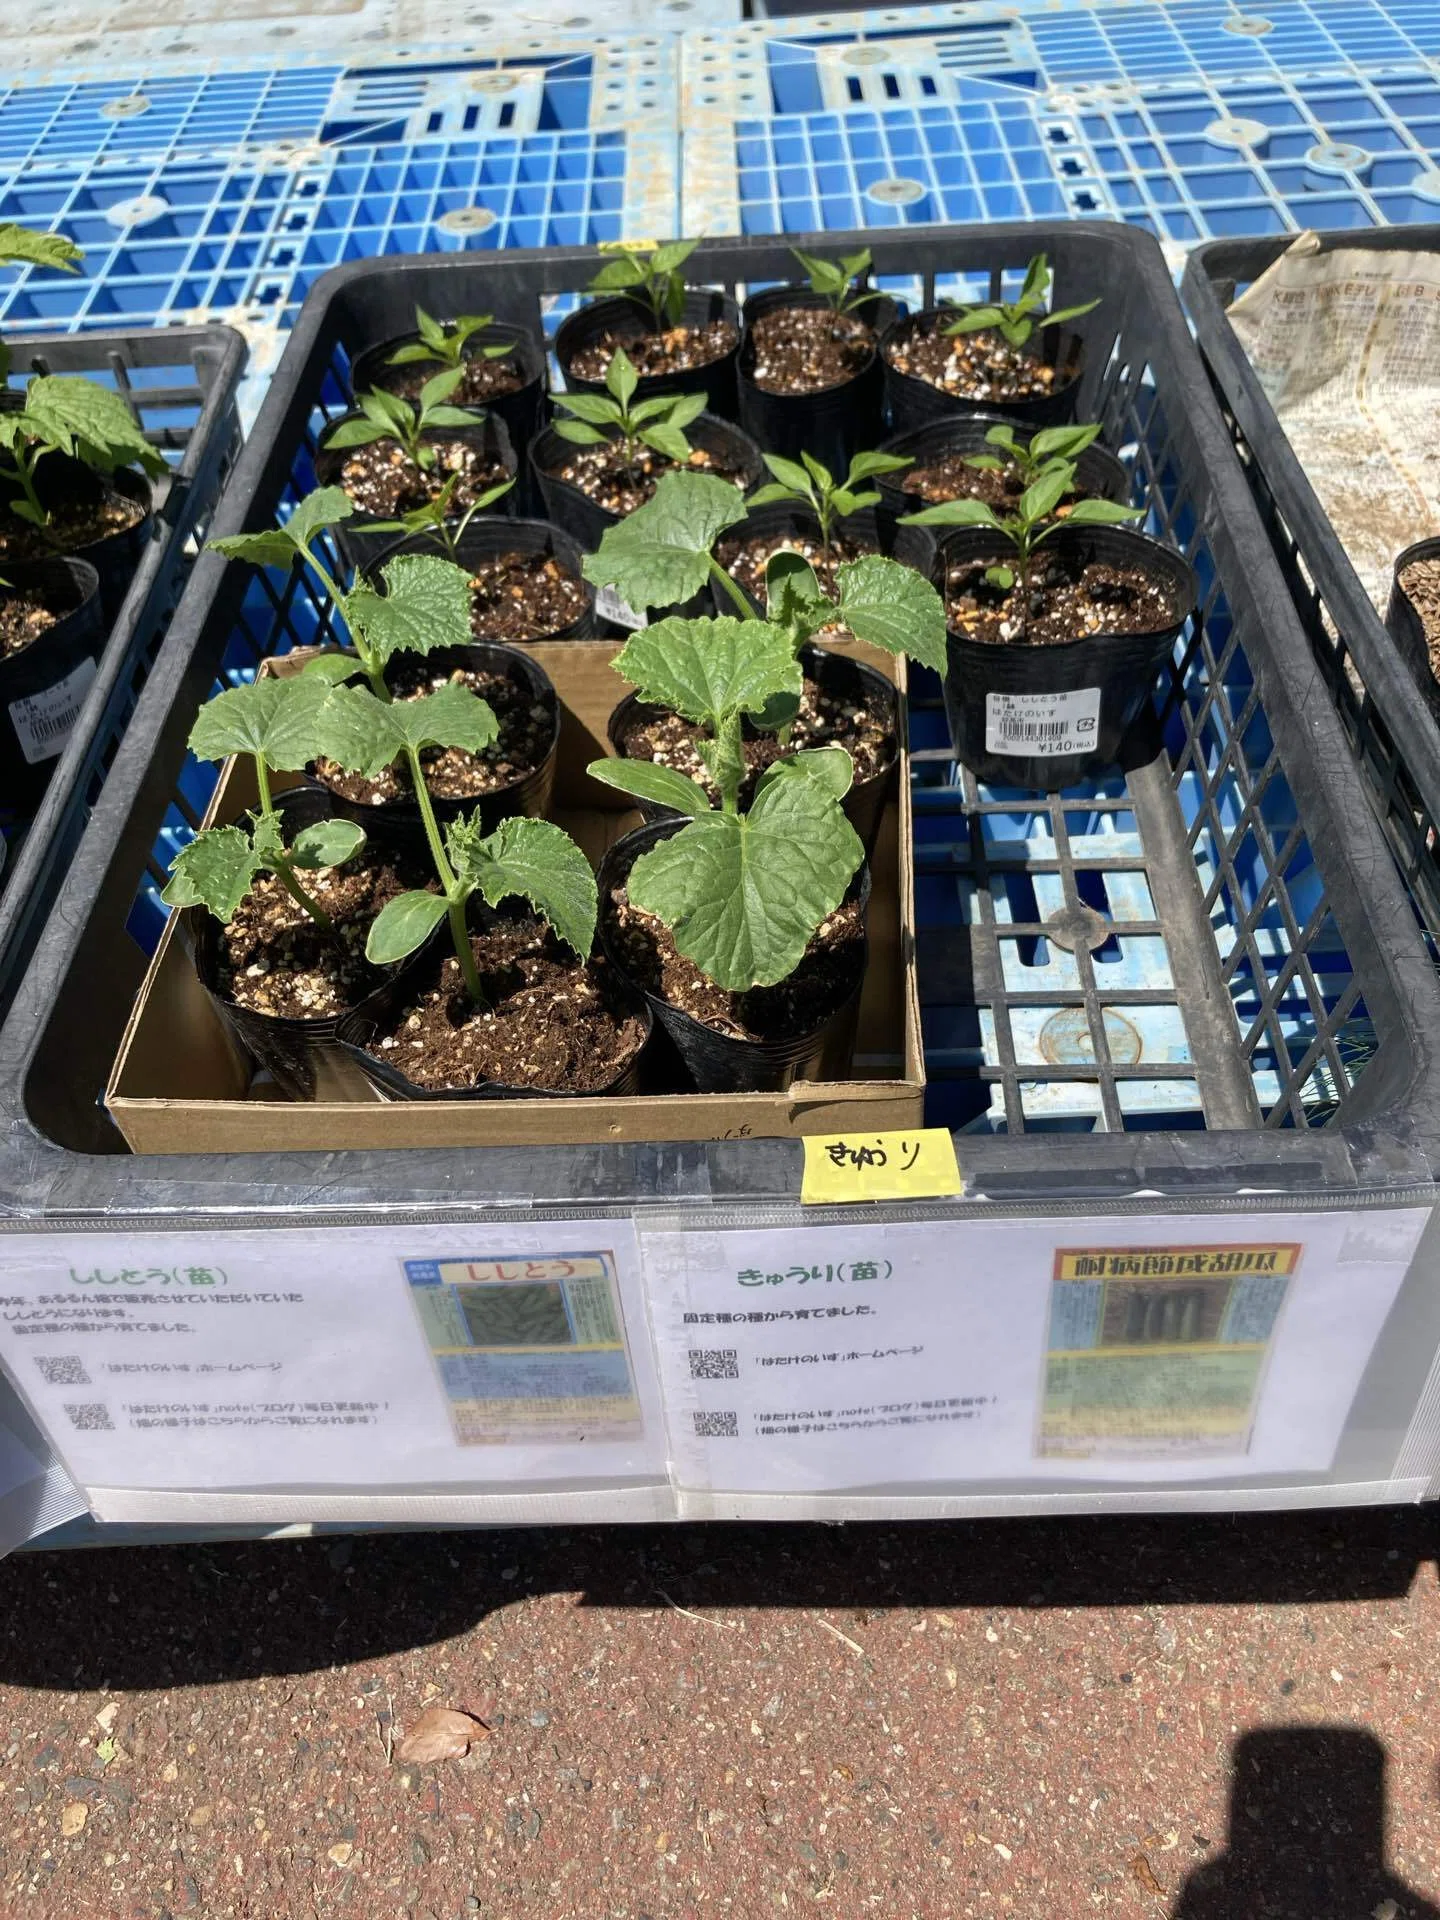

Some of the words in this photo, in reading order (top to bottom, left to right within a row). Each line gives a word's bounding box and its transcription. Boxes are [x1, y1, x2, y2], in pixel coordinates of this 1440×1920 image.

[70, 1267, 228, 1286] ししとう（苗）
[467, 1260, 575, 1281] ししとう
[738, 1259, 893, 1287] きゅうり（苗）
[683, 1305, 877, 1324] 固定種の種から育てました。
